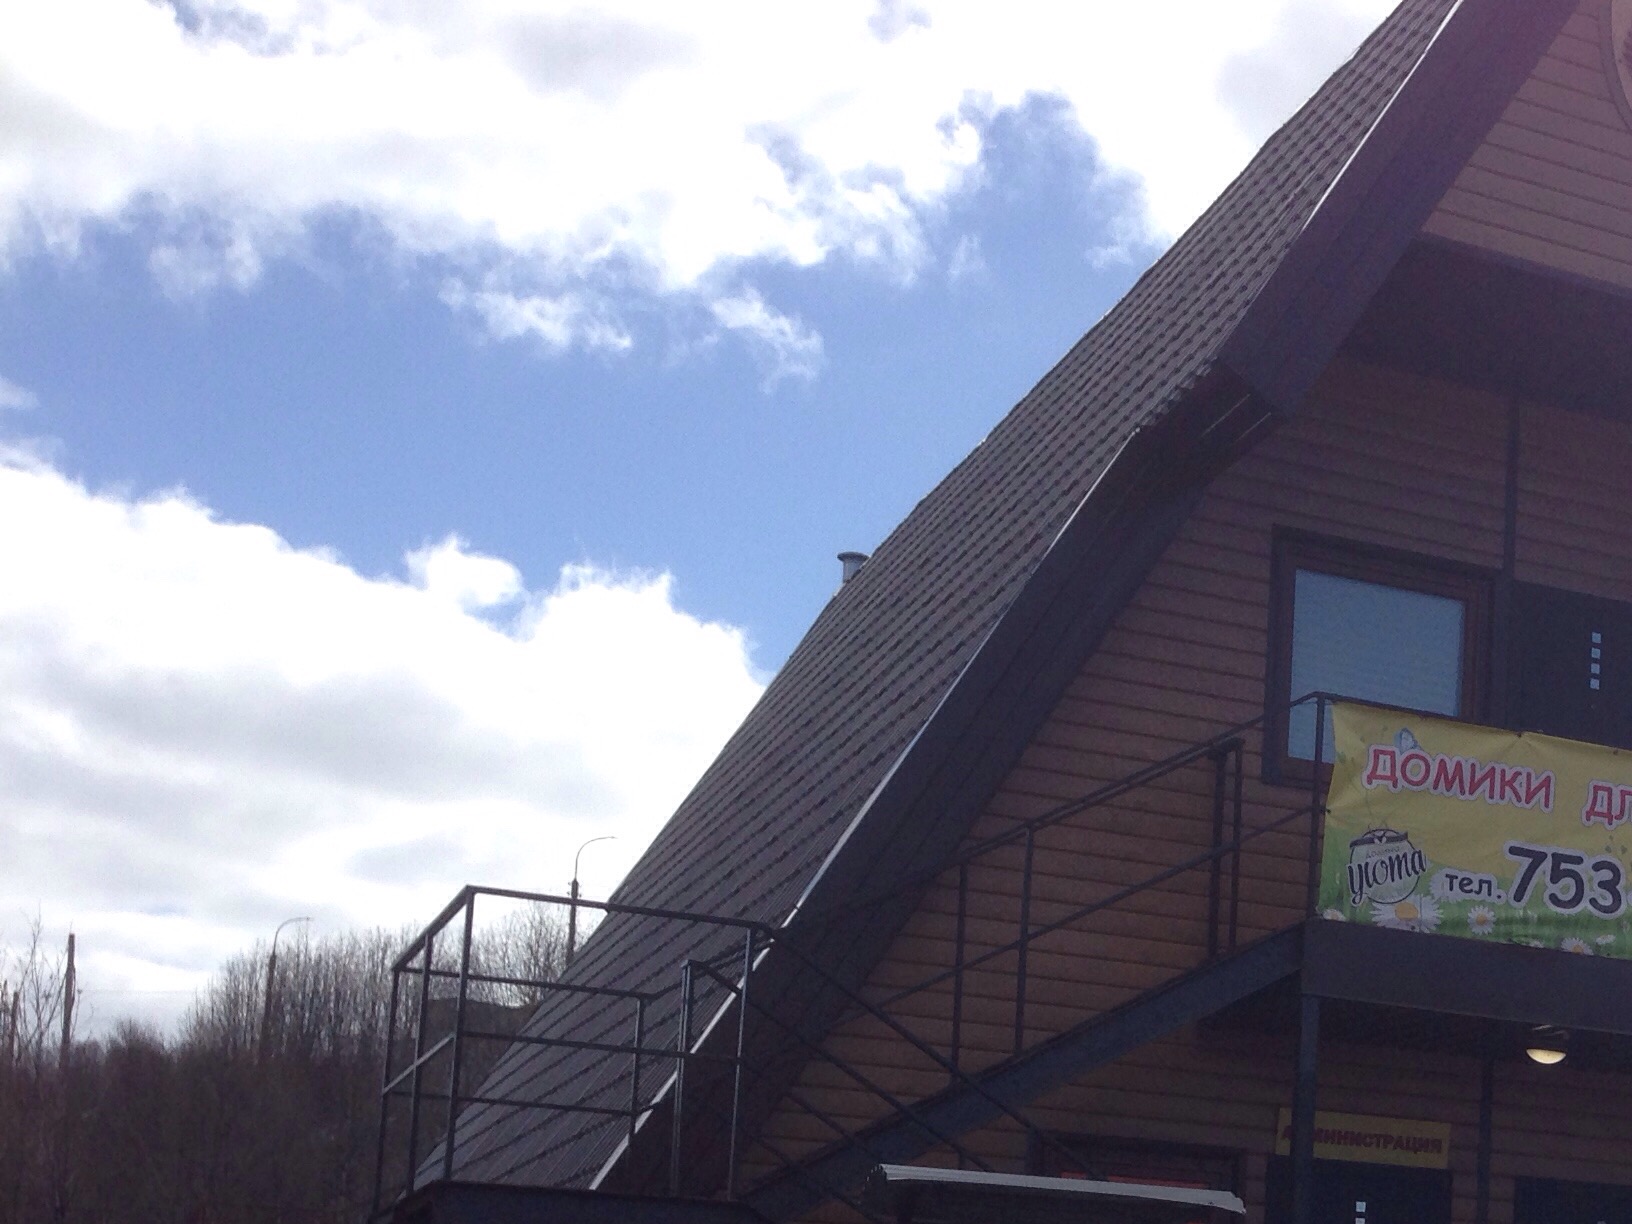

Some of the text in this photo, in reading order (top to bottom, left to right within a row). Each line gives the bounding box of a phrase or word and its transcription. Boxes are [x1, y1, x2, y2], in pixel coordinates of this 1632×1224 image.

[1366, 748, 1552, 809] ДОМИКИ
[1445, 873, 1502, 900] тел.
[1281, 1124, 1443, 1155] АМИНИСТРАЦИЯ
